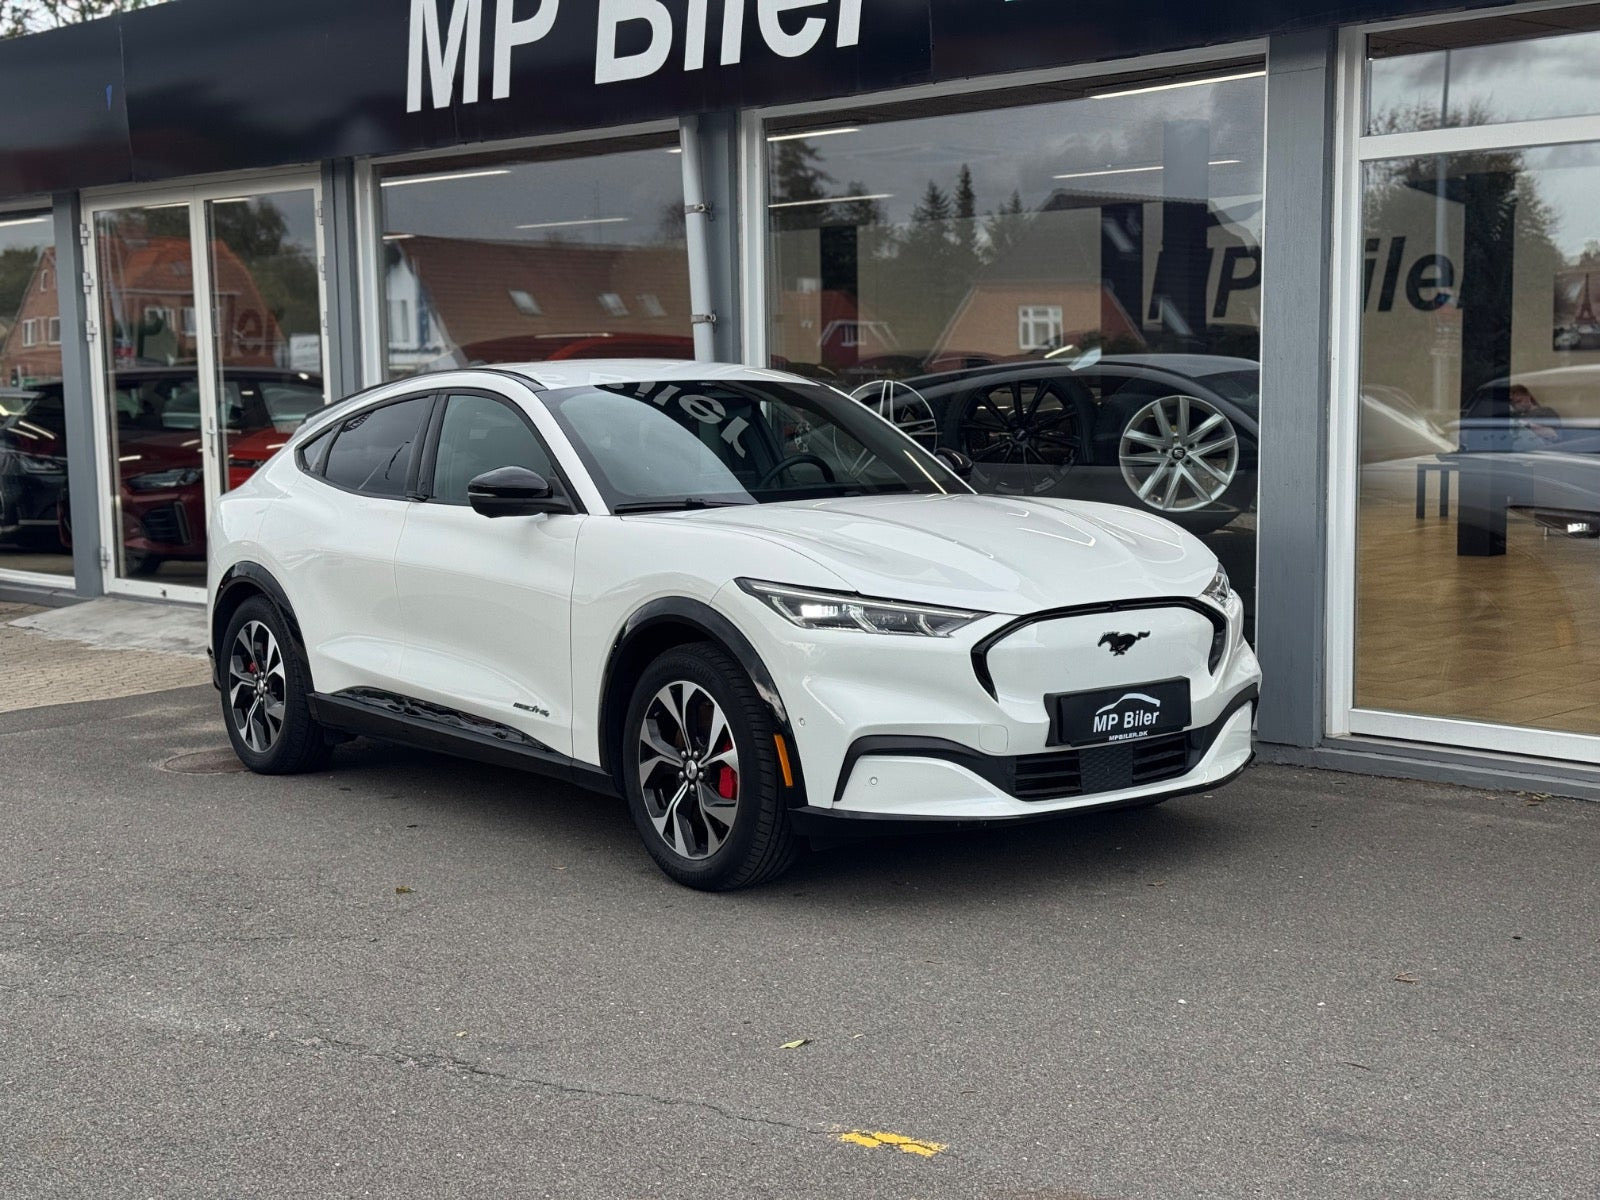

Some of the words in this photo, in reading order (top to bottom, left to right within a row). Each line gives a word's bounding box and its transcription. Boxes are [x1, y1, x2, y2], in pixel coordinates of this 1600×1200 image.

[406, 0, 560, 114] MP
[1363, 235, 1465, 313] ile
[1093, 713, 1119, 733] MP
[1123, 709, 1160, 729] Biler
[1108, 730, 1149, 742] MPBILER.DK
